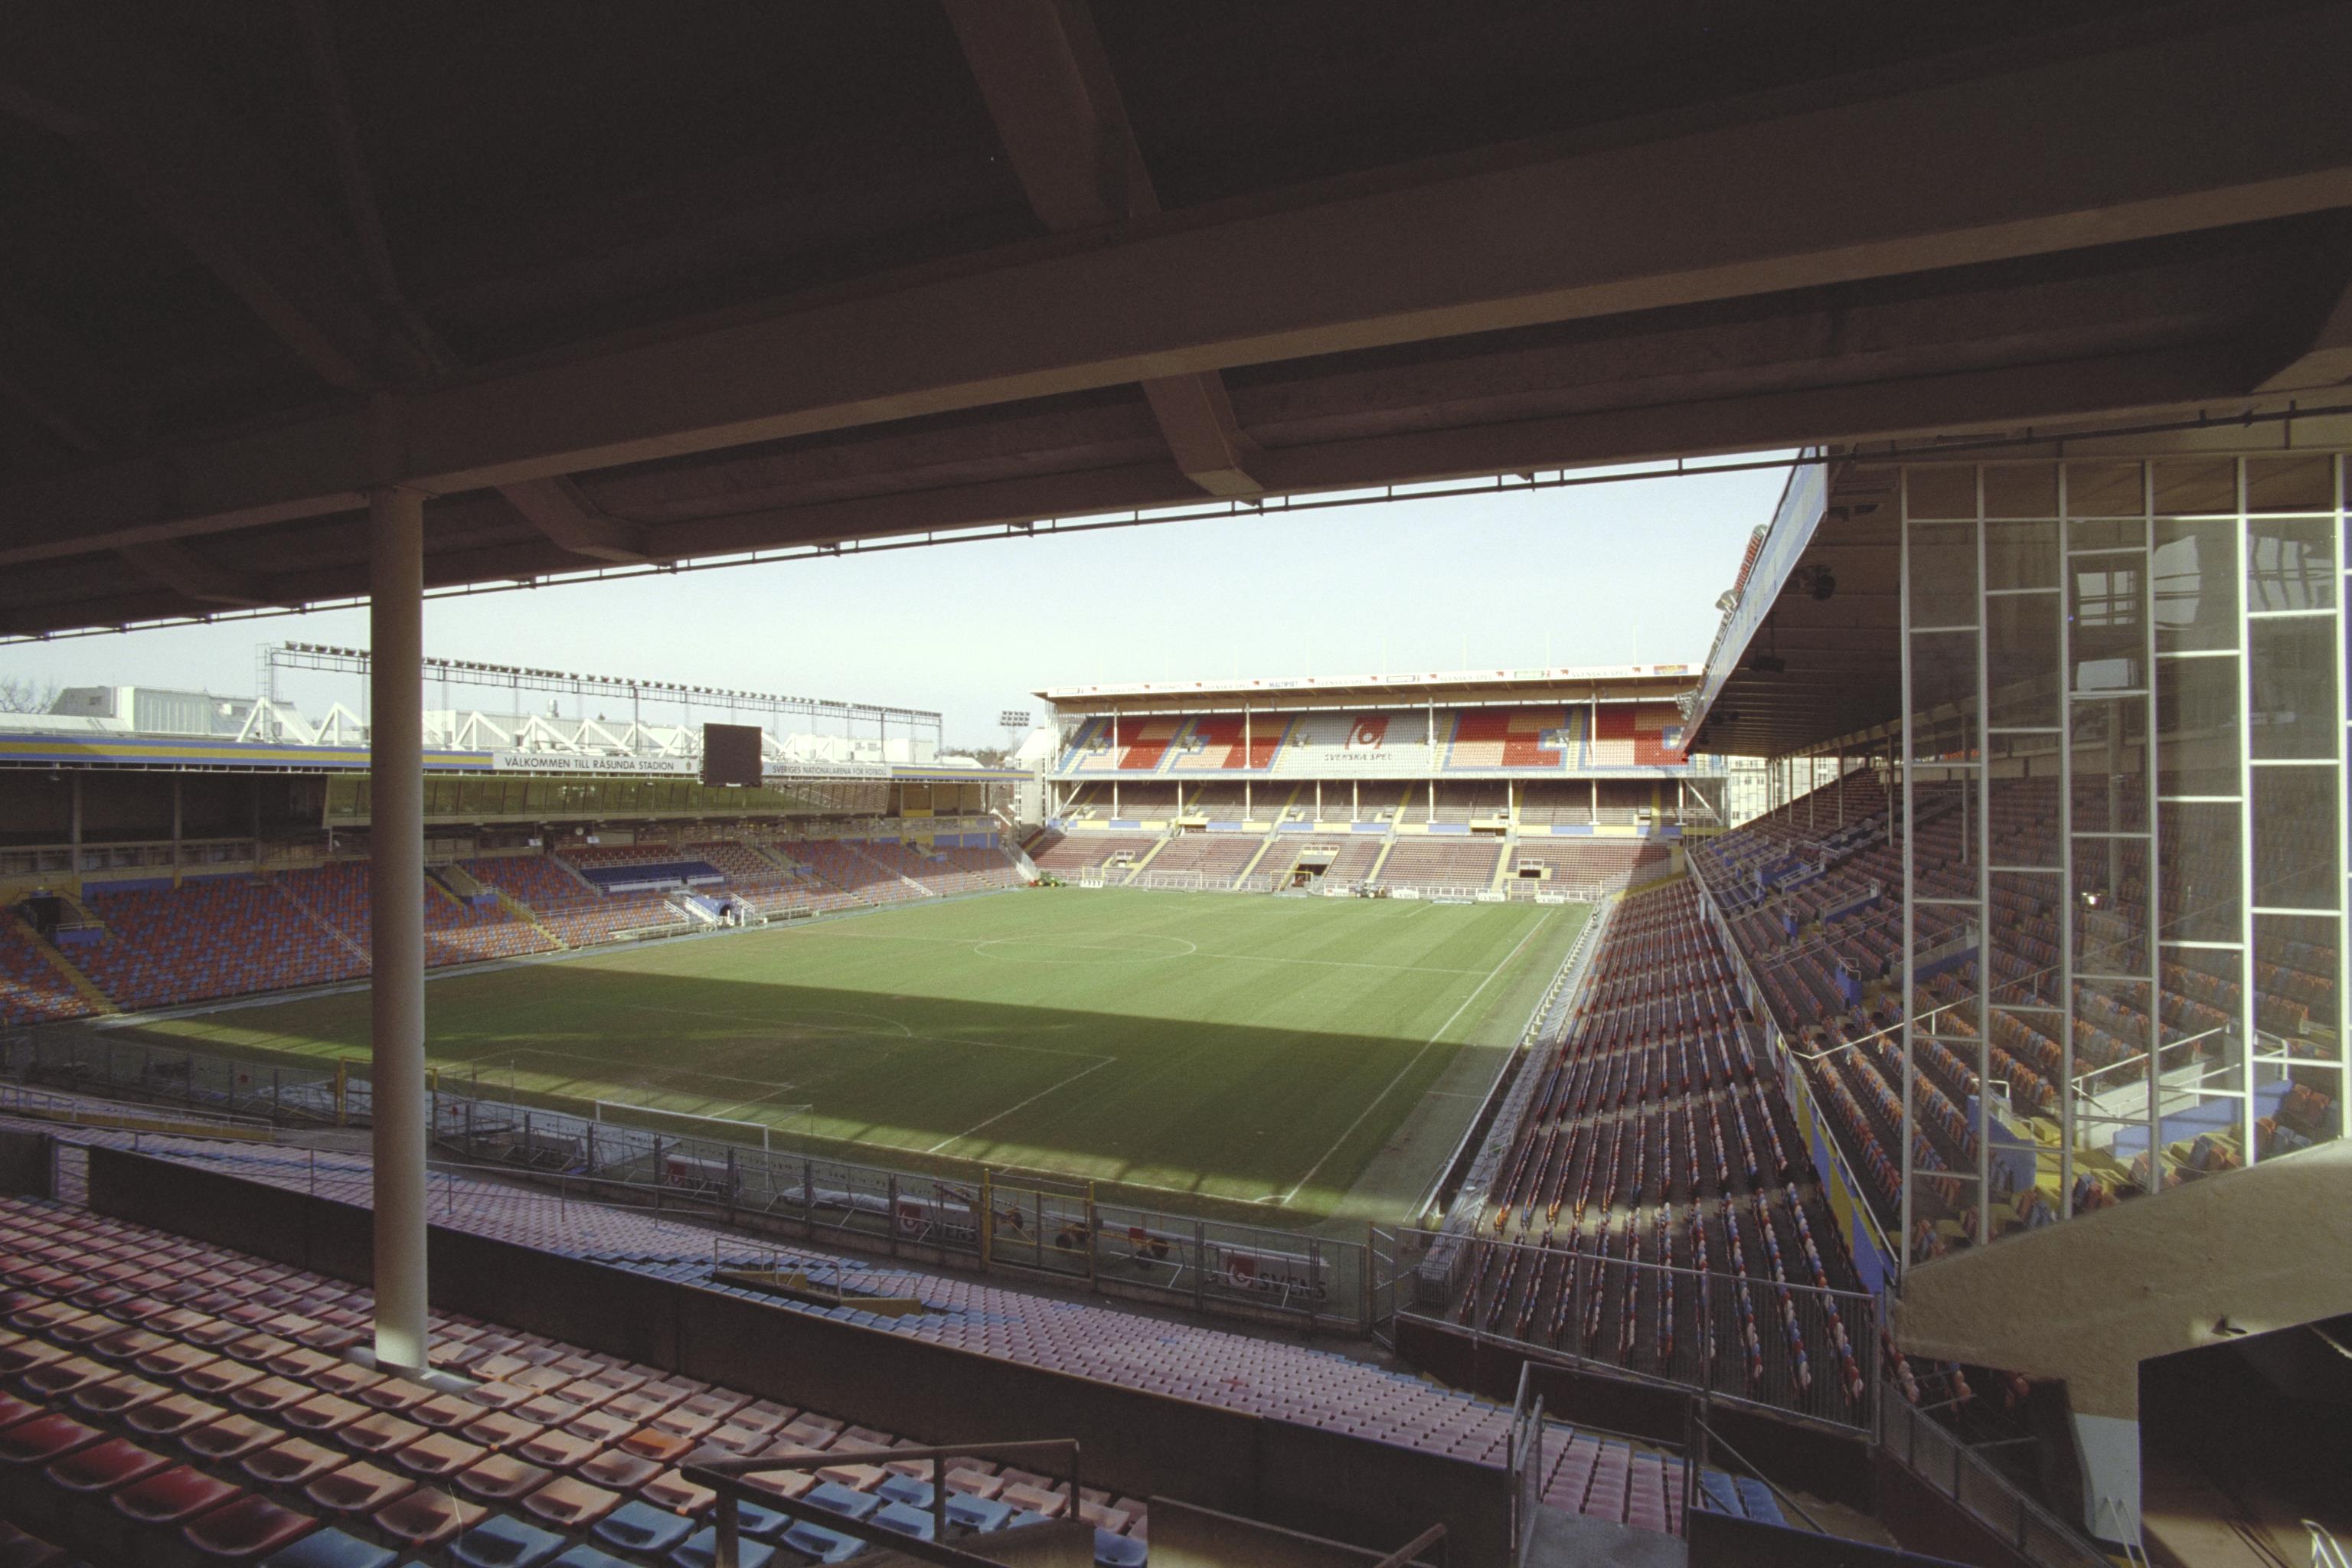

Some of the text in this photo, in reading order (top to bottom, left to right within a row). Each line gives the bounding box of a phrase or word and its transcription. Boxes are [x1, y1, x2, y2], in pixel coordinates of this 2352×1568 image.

[505, 756, 674, 770] VÄLKOMMEN TILL RÅSUNDA STADION
[1324, 753, 1367, 761] SVENSKA
[773, 765, 801, 774] SVERIGES
[803, 766, 851, 775] NATIONALARENA
[853, 766, 864, 775] FÖR
[1259, 1272, 1326, 1300] SVENS
